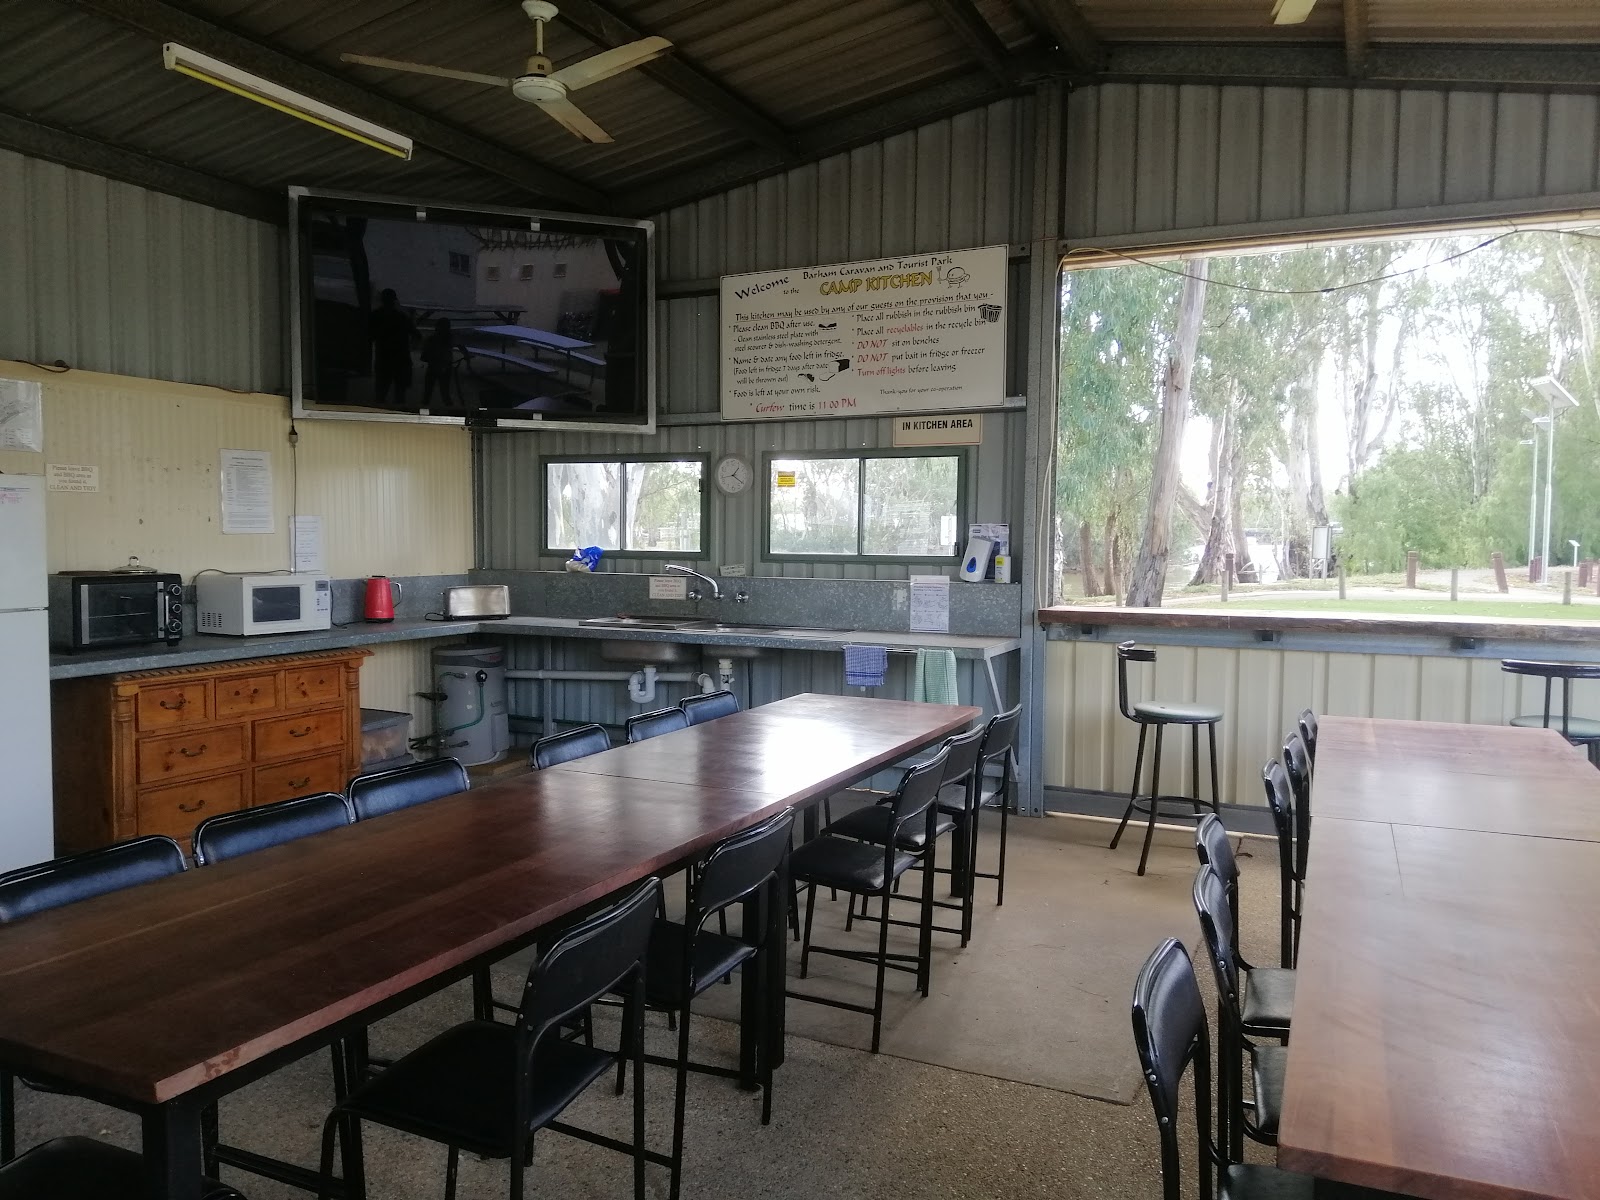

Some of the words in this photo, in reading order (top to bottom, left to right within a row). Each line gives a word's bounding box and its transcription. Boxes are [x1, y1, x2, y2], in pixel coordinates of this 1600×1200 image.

[803, 270, 837, 280] Barham
[840, 266, 876, 276] Caravan
[897, 259, 928, 269] Tourist
[931, 256, 953, 266] Park
[734, 276, 790, 300] Welcome
[819, 278, 863, 296] CAMP
[866, 270, 933, 292] KITCHEN
[736, 313, 749, 321] This
[750, 311, 775, 320] kitchen
[794, 308, 802, 316] be
[804, 306, 819, 315] used
[820, 305, 830, 314] by
[831, 305, 846, 314] any
[847, 303, 855, 312] of
[870, 300, 893, 311] guests
[905, 297, 918, 306] the
[920, 295, 954, 306] provision
[956, 292, 971, 301] that
[973, 293, 988, 301] you
[856, 314, 874, 322] Place
[876, 312, 884, 320] all
[886, 310, 912, 320] rubbish
[922, 308, 934, 316] the
[935, 306, 962, 316] rubbish
[964, 304, 976, 312] bin
[733, 324, 751, 333] Please
[770, 321, 785, 330] BBQ
[786, 320, 801, 329] after
[857, 328, 874, 336] Place
[875, 326, 884, 335] all
[886, 324, 923, 334] recyclables
[935, 321, 946, 330] the
[948, 320, 972, 329] recycle
[974, 318, 986, 326] bin
[790, 331, 803, 340] plate
[857, 340, 869, 350] DO
[870, 339, 888, 348] NOT
[912, 336, 939, 345] benches
[733, 357, 751, 365] Name
[775, 355, 788, 363] any
[789, 353, 802, 361] food
[803, 351, 814, 359] left
[857, 354, 869, 363] DO
[870, 352, 889, 362] NOT
[891, 354, 903, 362] put
[905, 352, 918, 360] bait
[929, 350, 949, 359] fridge
[961, 347, 985, 355] freezer
[748, 365, 758, 374] left
[765, 364, 781, 373] fridge
[858, 368, 875, 376] Turn
[876, 367, 887, 376] off
[887, 367, 905, 376] lights
[908, 365, 929, 374] before
[930, 364, 956, 372] leaving
[754, 388, 765, 396] left
[755, 402, 785, 413] Curfew
[789, 403, 806, 411] time
[809, 402, 815, 411] is
[841, 398, 856, 408] PM
[902, 421, 911, 431] IN
[913, 420, 948, 430] KITCHEN
[950, 419, 973, 428] AREA
